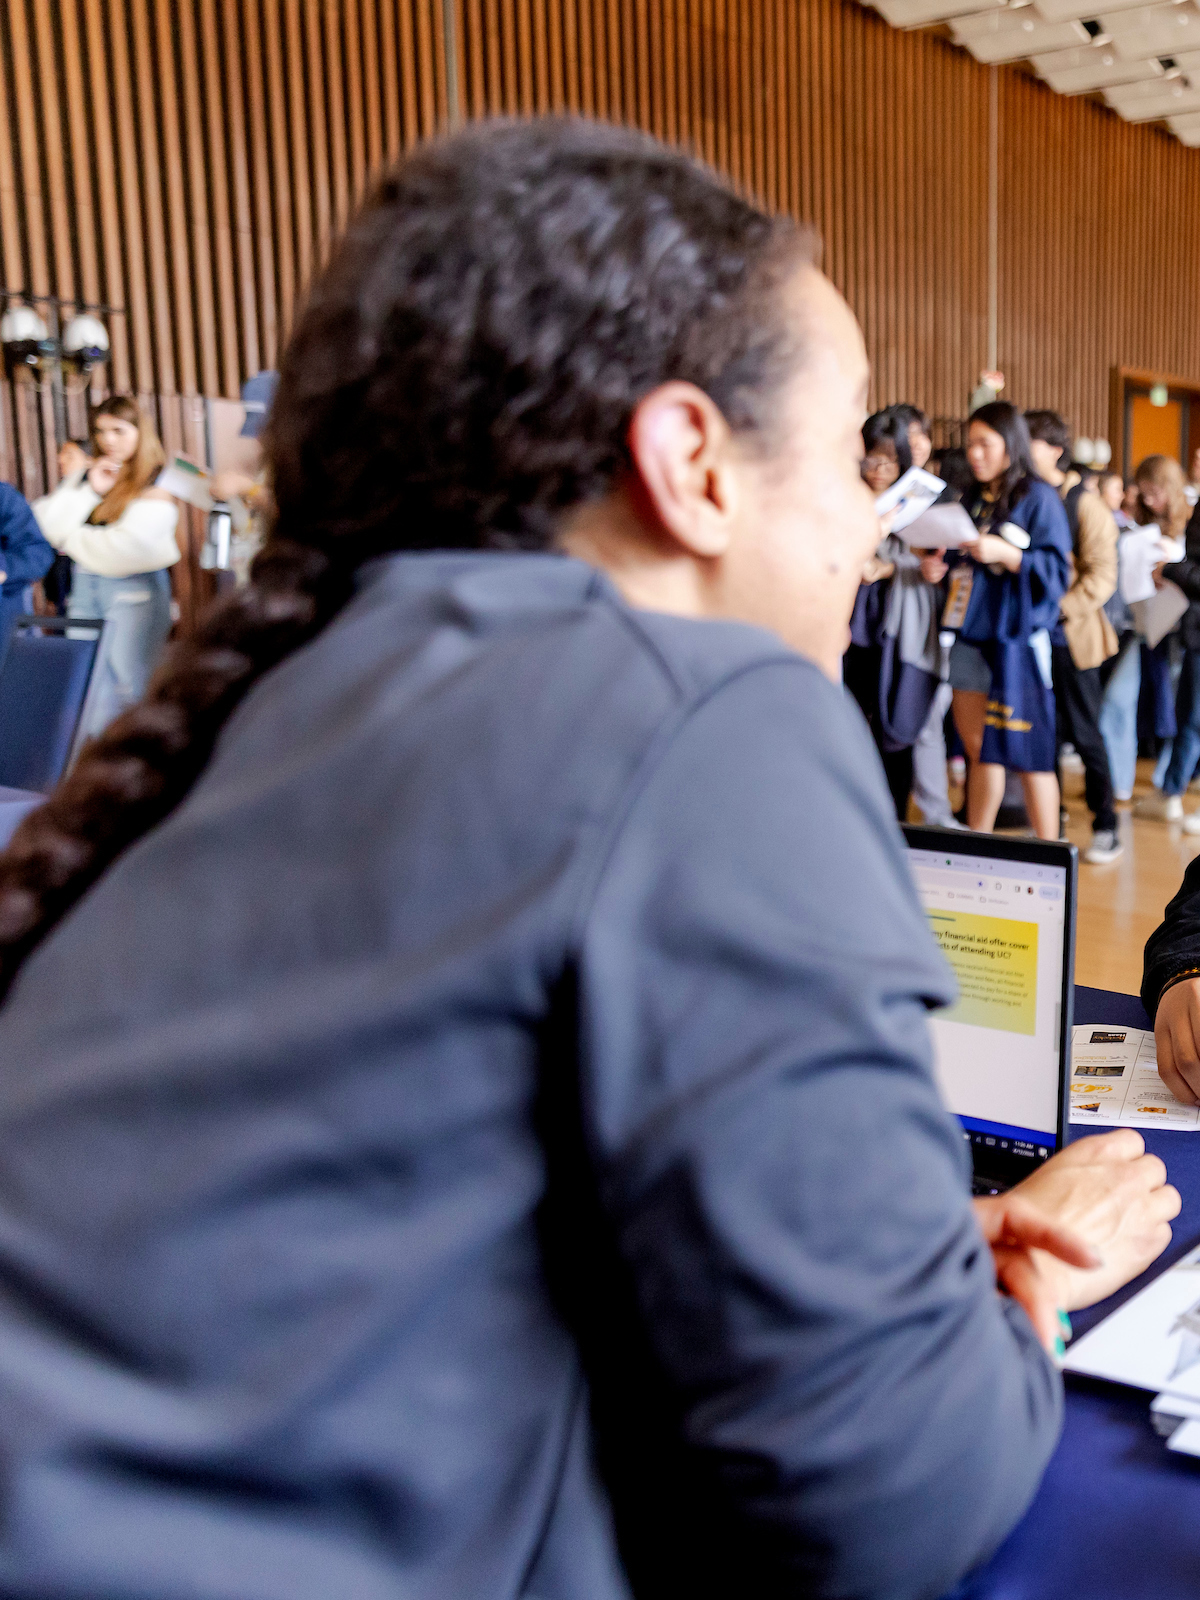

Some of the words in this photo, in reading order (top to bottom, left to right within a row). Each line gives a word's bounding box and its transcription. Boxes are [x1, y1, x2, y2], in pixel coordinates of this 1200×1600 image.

[945, 931, 976, 942] financial
[989, 938, 1008, 947] offer
[1009, 942, 1030, 951] cover
[951, 943, 959, 951] of
[960, 945, 996, 960] attending
[996, 950, 1012, 960] UC?
